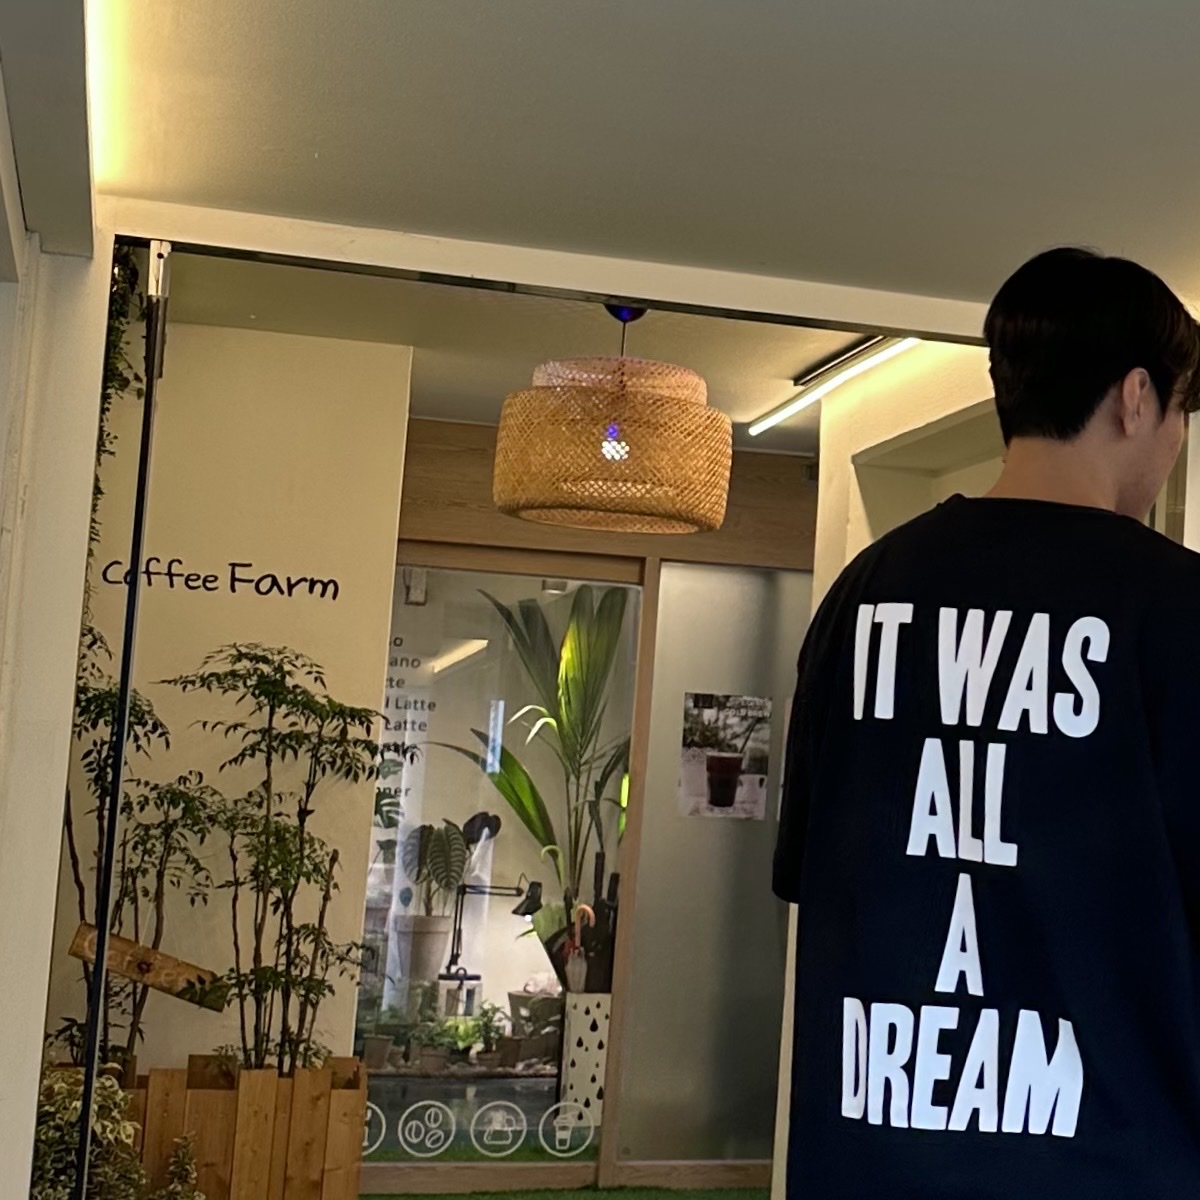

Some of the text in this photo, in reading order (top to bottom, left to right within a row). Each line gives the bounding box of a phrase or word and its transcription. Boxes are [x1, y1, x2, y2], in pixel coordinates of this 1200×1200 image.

[228, 562, 340, 600] Farm
[395, 697, 437, 712] Latte
[853, 602, 1111, 738] IT WAS
[905, 737, 1018, 867] ALL
[934, 872, 984, 997] A
[841, 996, 1084, 1138] DREAM
